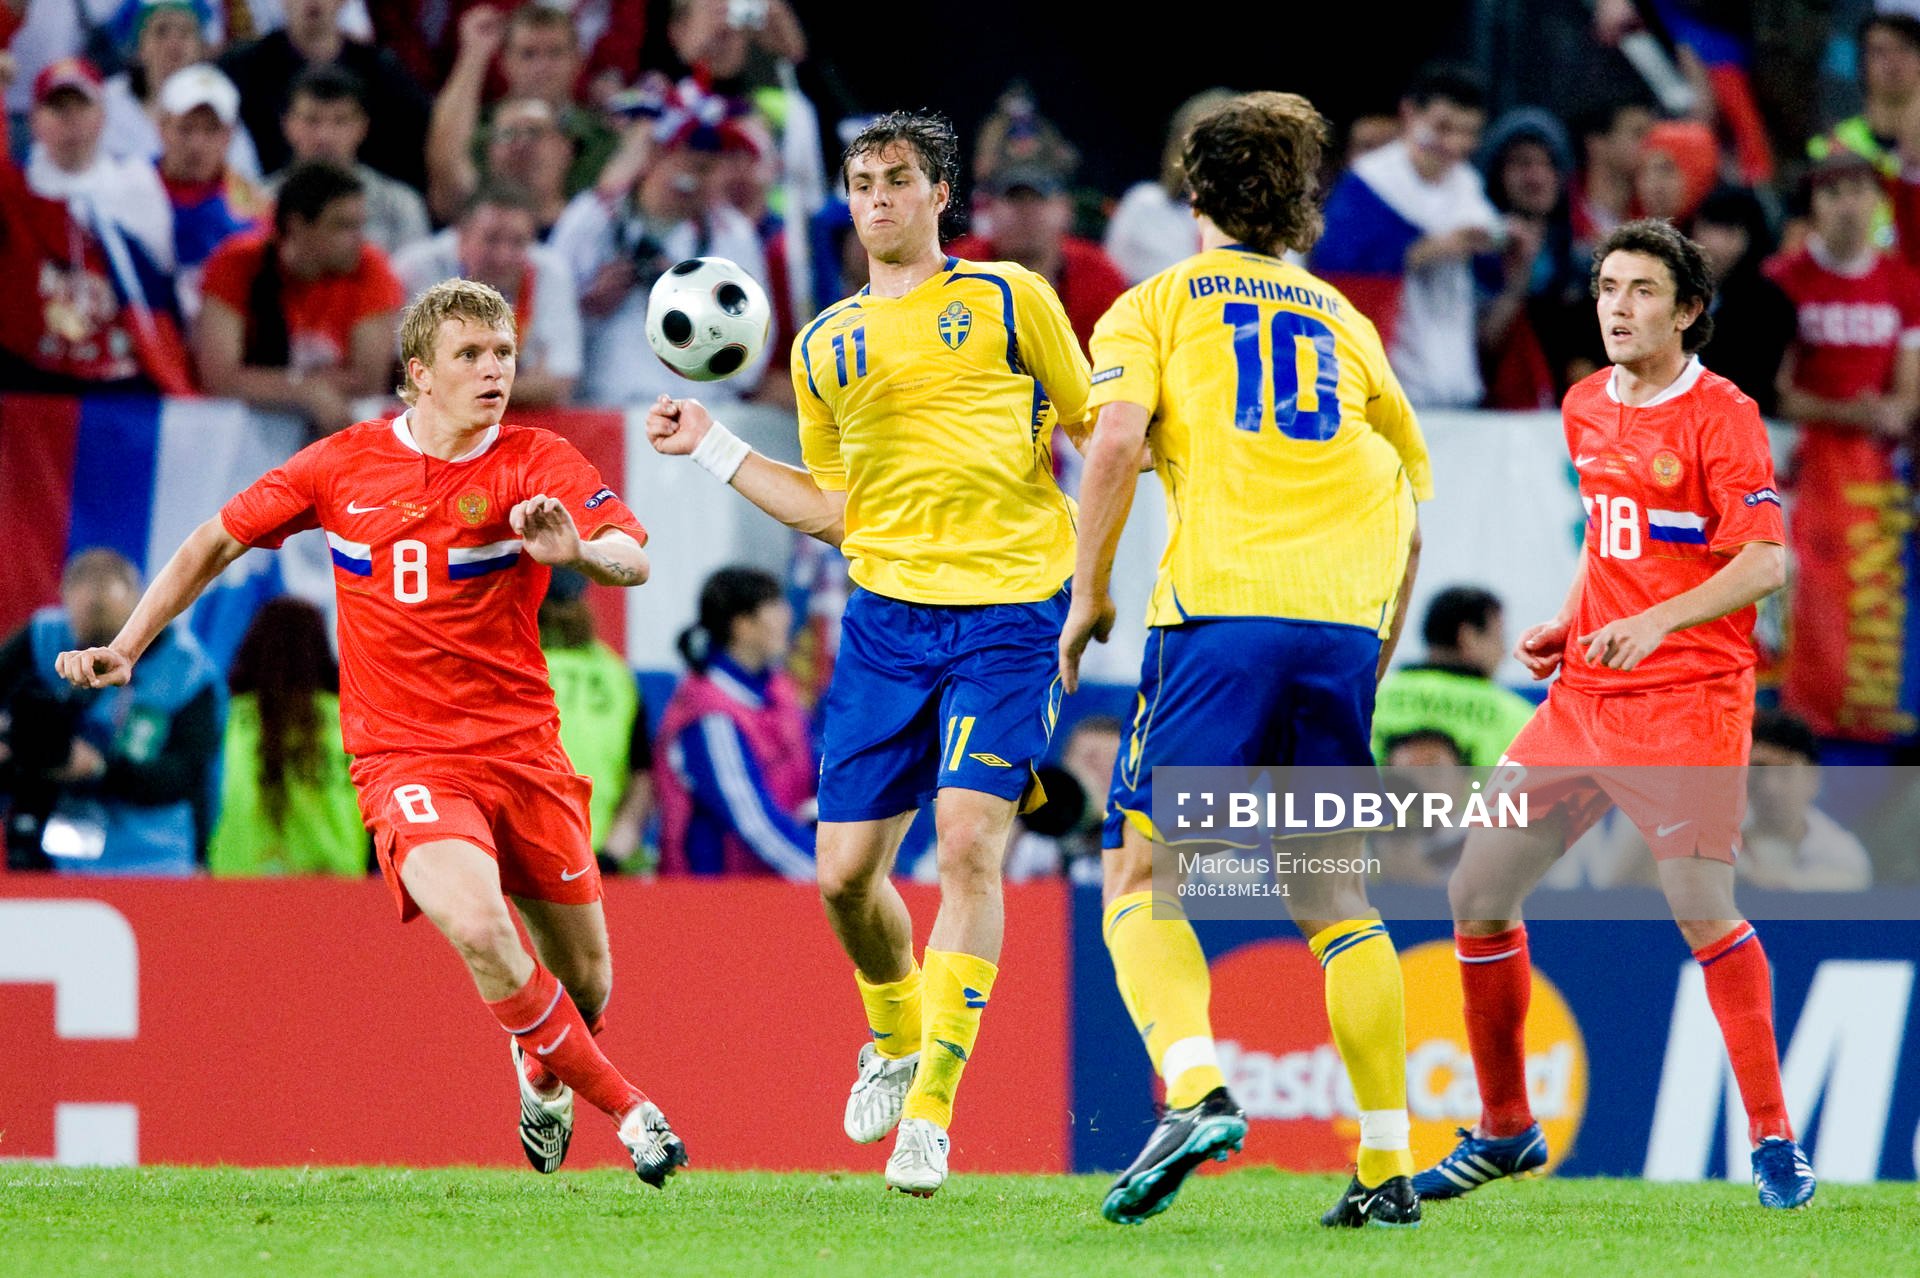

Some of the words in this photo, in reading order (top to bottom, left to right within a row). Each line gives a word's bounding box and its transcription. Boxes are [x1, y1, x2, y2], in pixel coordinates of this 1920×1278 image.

[832, 326, 867, 388] 11
[1223, 302, 1341, 441] 10
[1596, 494, 1641, 560] 18
[393, 539, 428, 604] 8
[393, 783, 440, 823] 8
